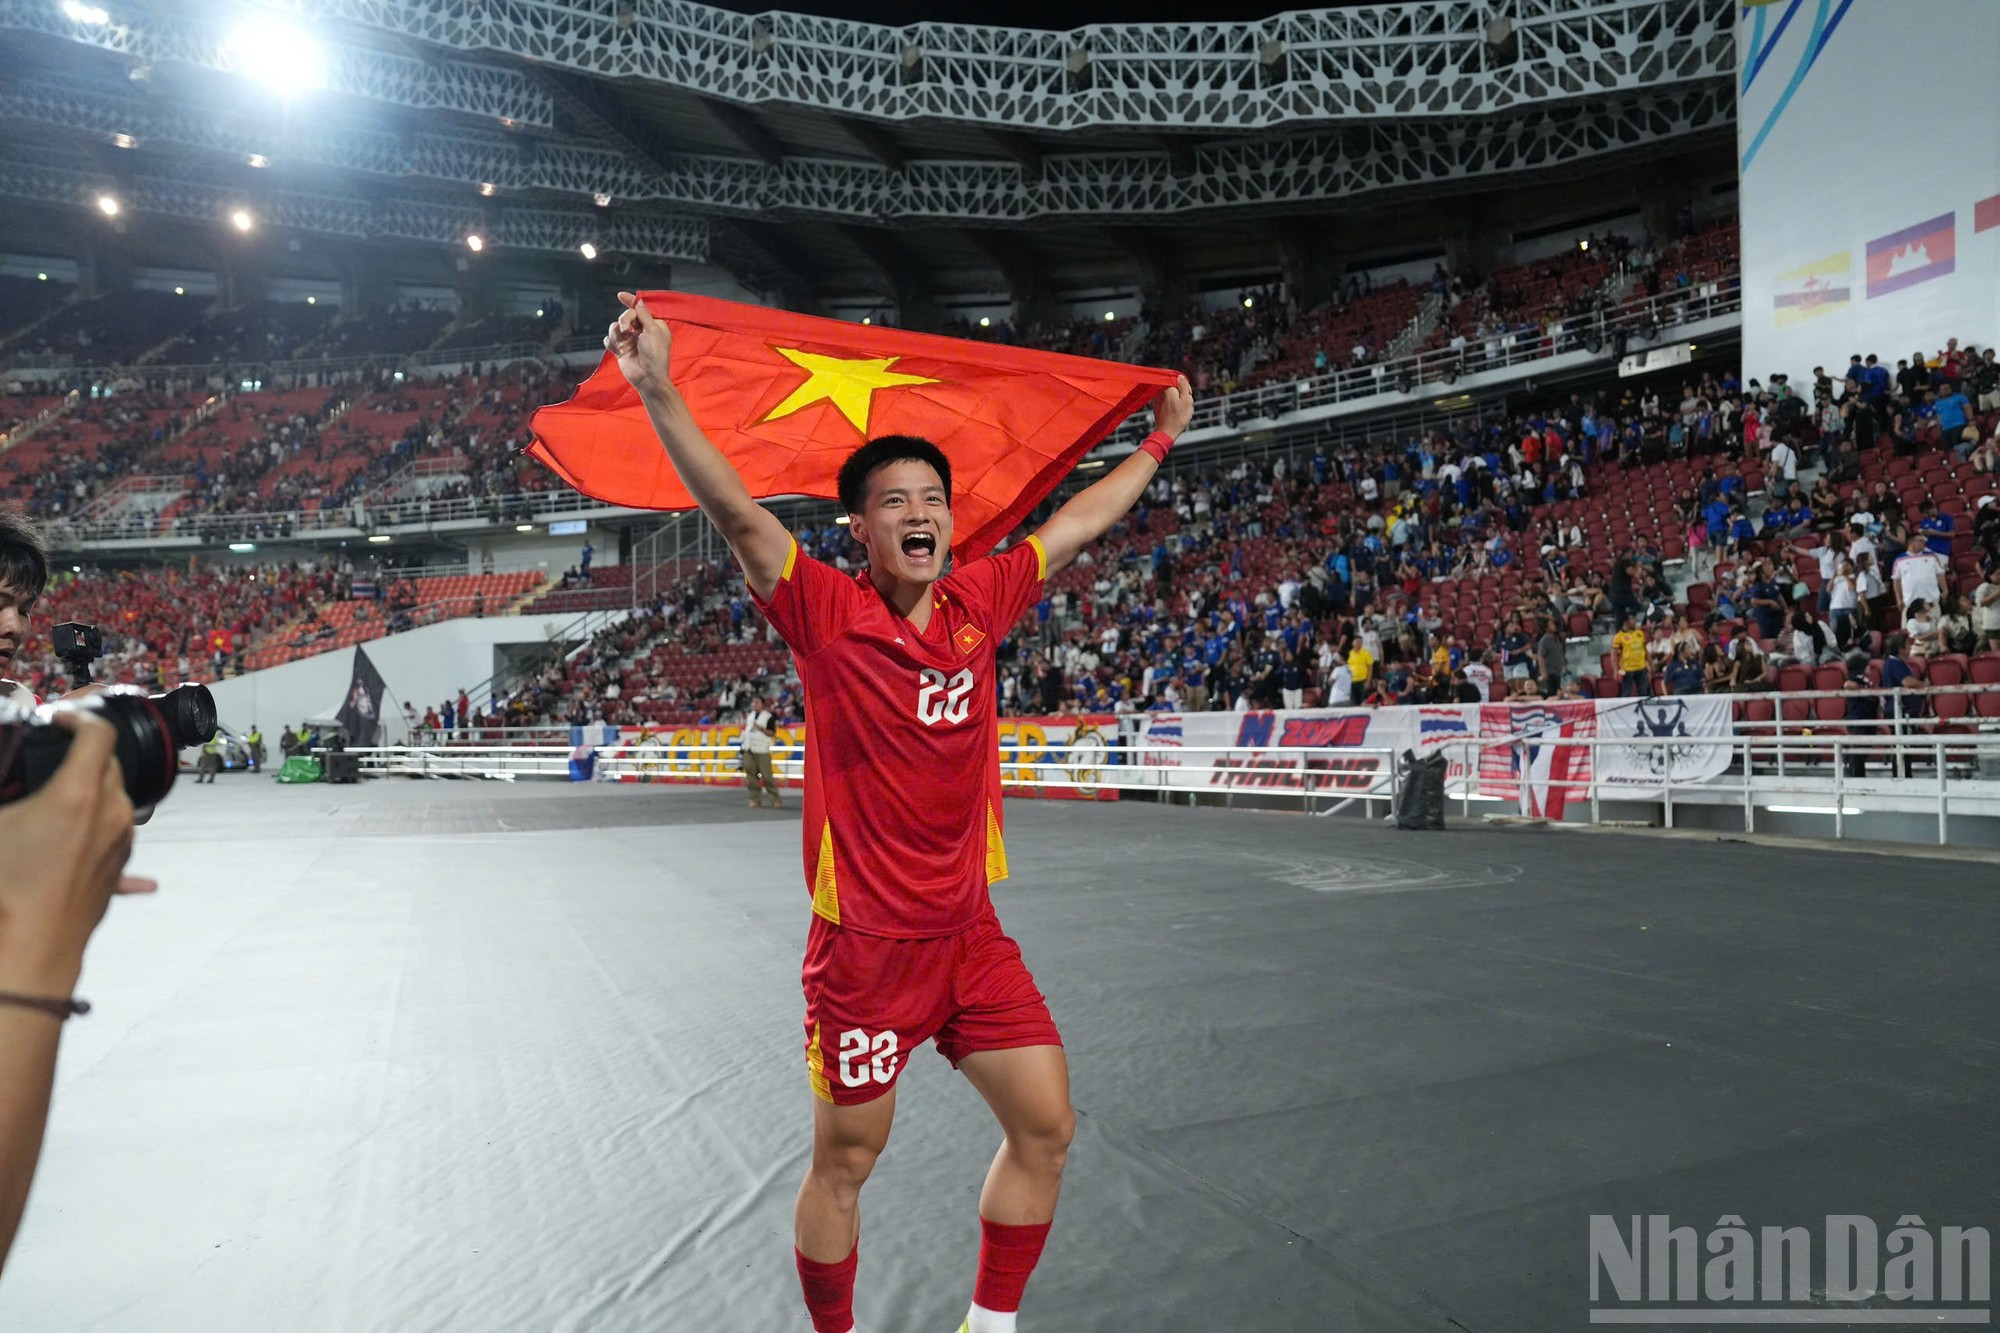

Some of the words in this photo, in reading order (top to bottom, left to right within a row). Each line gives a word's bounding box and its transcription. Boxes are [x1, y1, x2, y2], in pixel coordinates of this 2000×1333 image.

[917, 667, 974, 726] 22
[1209, 757, 1380, 788] THAILAND
[838, 1028, 899, 1088] 22
